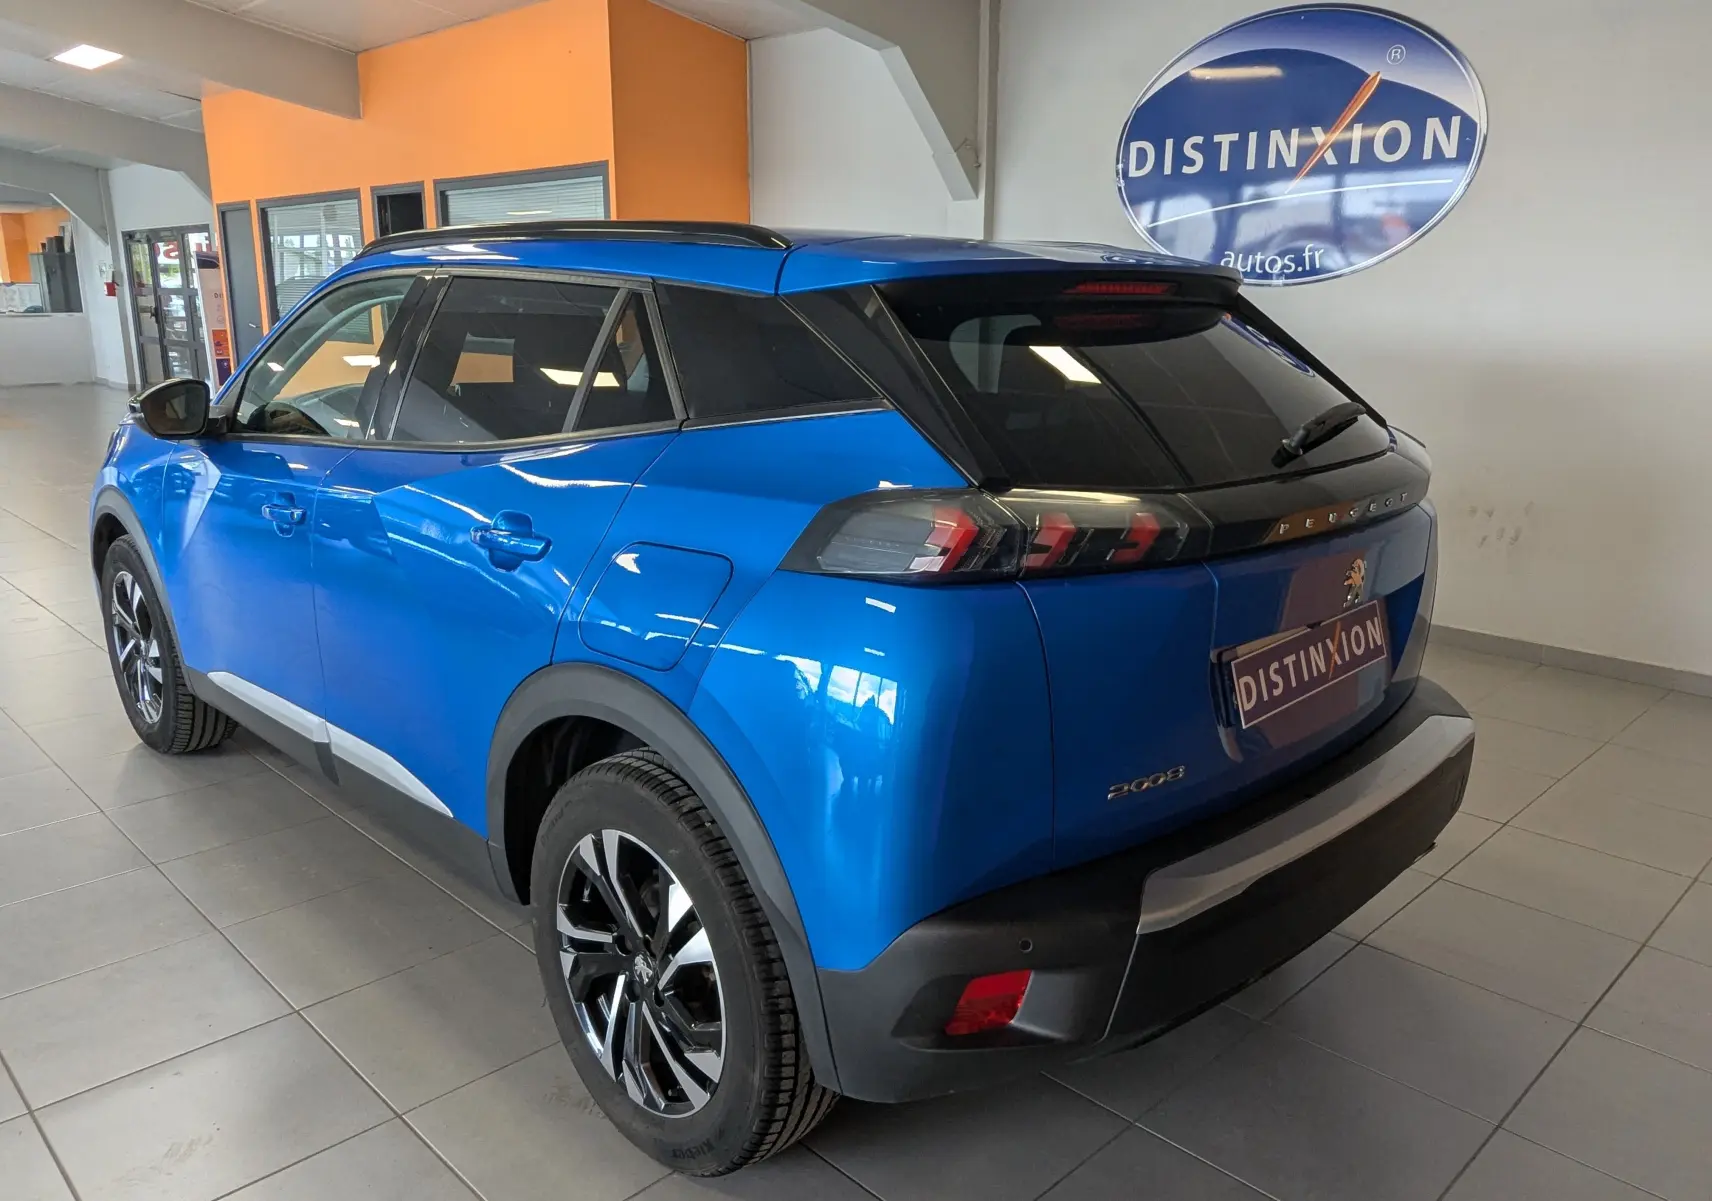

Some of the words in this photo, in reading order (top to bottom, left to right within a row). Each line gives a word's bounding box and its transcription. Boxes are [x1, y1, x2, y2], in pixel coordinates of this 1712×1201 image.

[1128, 115, 1461, 178] DISTINXION
[1221, 244, 1324, 274] autos.fr
[1279, 492, 1408, 534] PEUGEOT
[1239, 617, 1382, 711] DISTINXION
[1107, 765, 1185, 800] 2008
